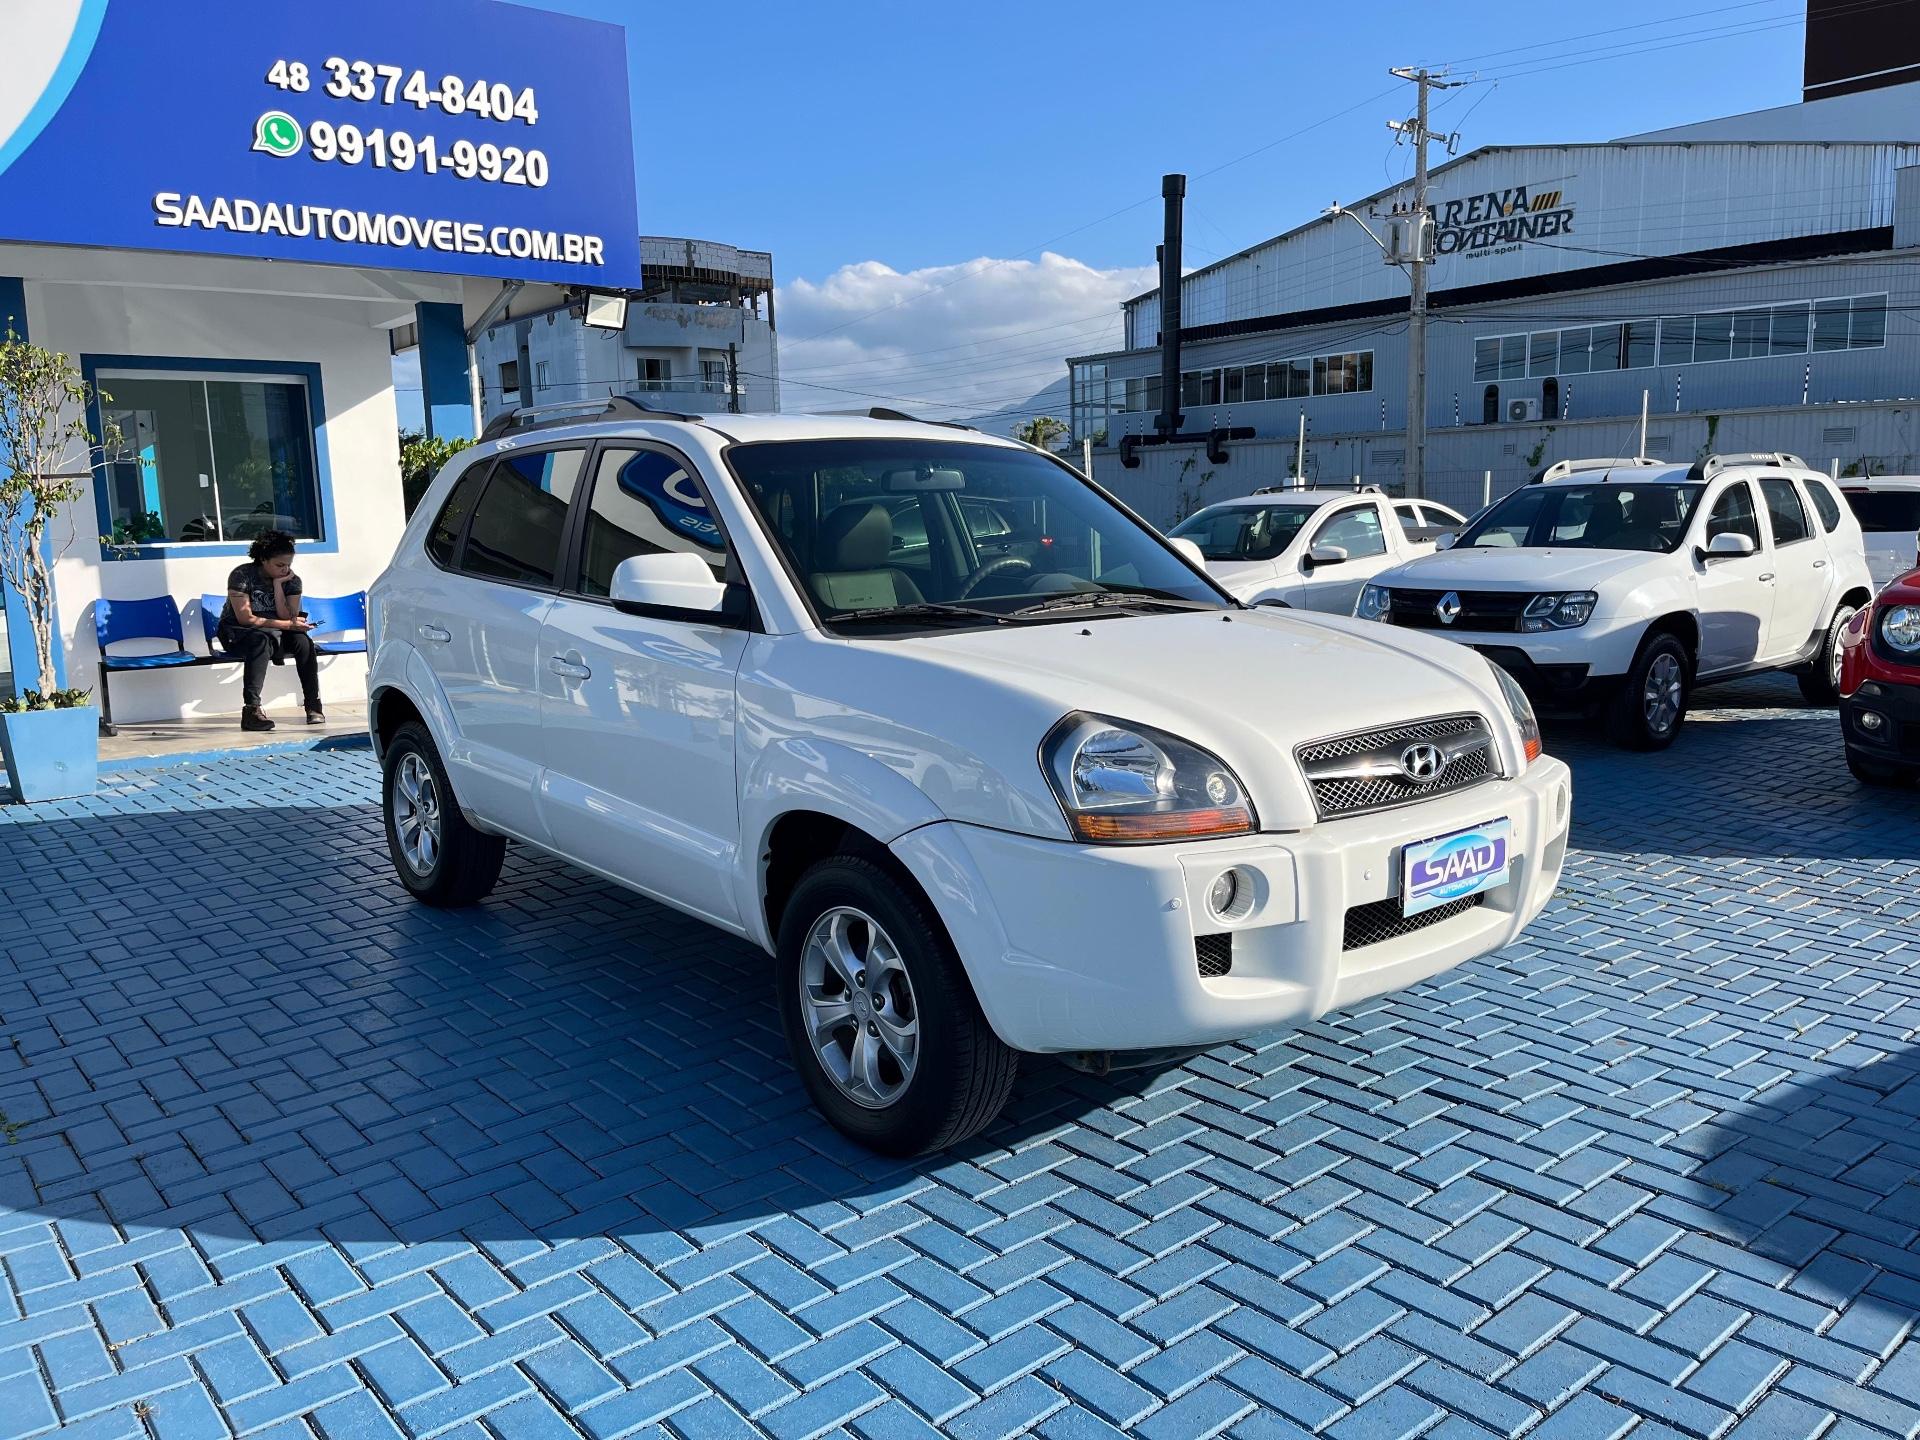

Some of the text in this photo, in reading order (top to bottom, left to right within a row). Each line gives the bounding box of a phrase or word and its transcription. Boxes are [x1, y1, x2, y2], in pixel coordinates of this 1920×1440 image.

[266, 56, 539, 125] 48 3374-8404
[309, 120, 549, 188] 99191-9920
[154, 192, 605, 266] SAADAUTOMOVEIS.COM.BR
[1433, 208, 1575, 255] ONTAINER
[1420, 841, 1496, 885] SAAD
